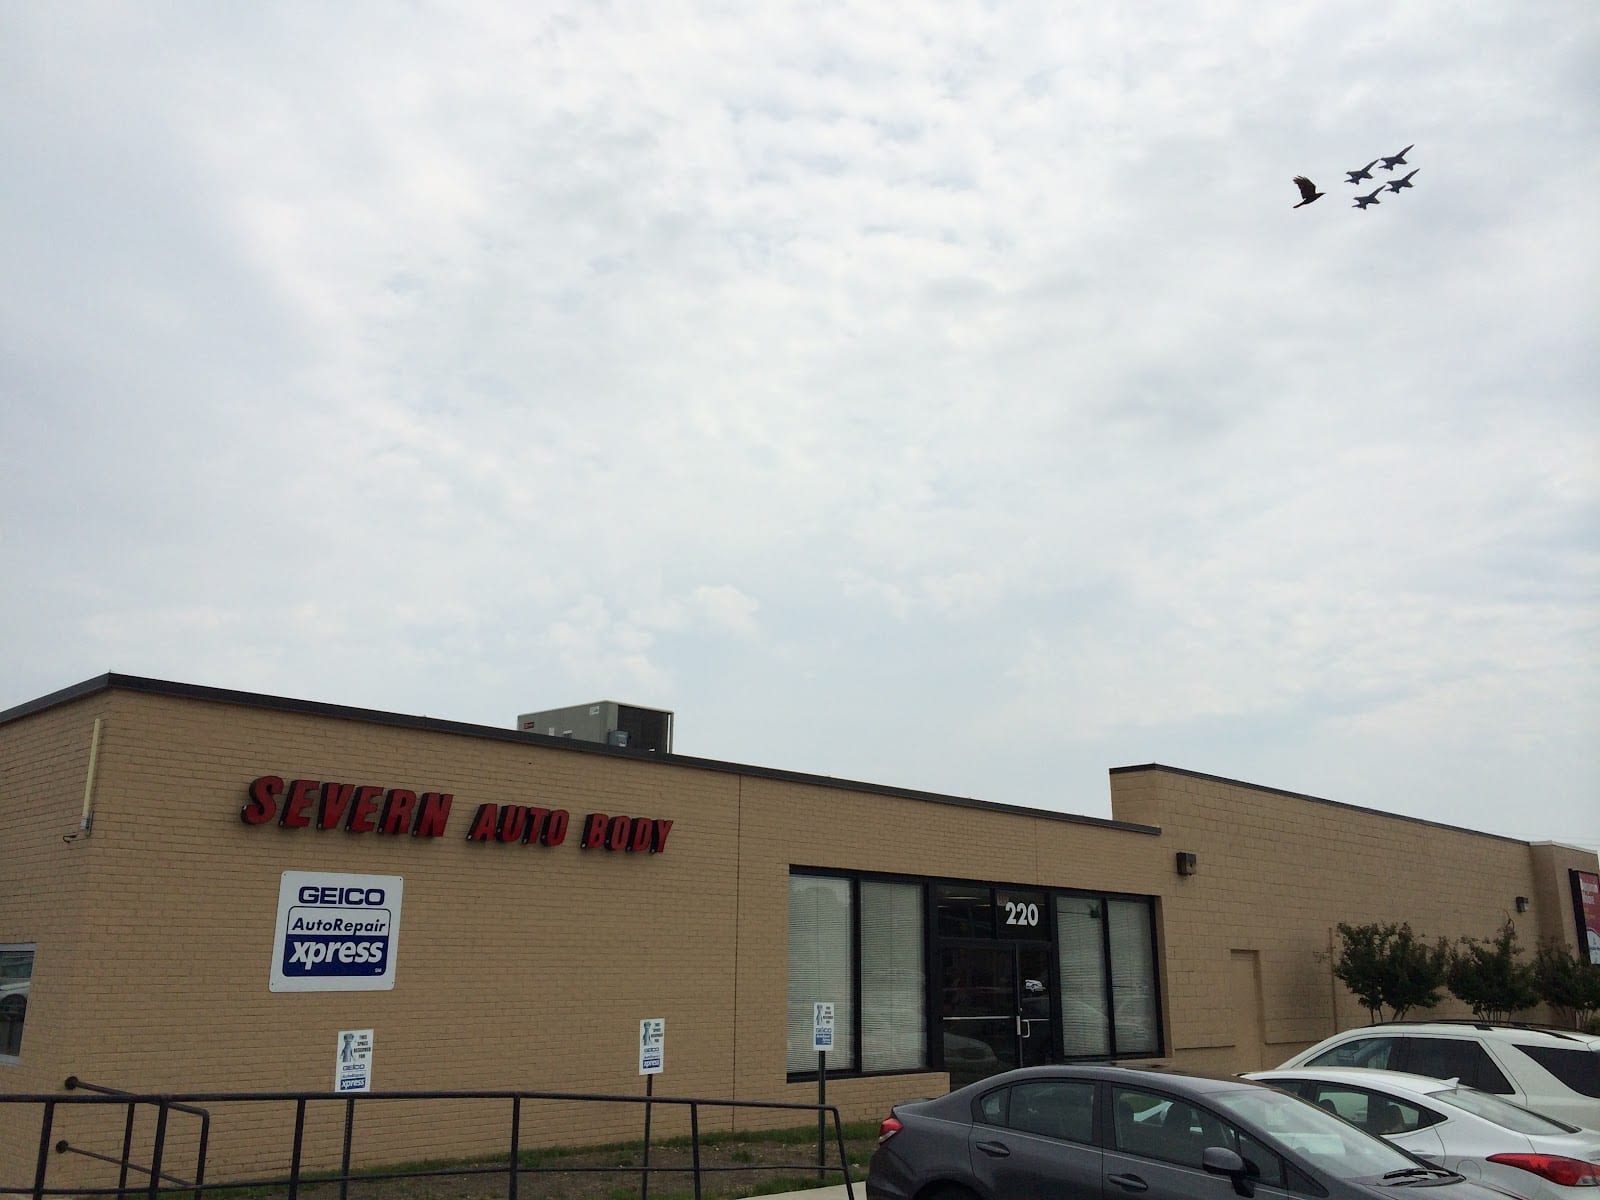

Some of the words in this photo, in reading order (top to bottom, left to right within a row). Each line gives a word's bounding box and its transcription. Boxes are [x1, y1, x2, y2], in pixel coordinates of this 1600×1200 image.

[241, 775, 453, 838] SEVERN
[467, 803, 570, 847] AUTO
[581, 813, 674, 854] BODY
[298, 886, 385, 906] GEICO
[291, 917, 386, 935] AutoRepair
[1005, 902, 1039, 927] 220
[288, 939, 383, 970] xpress
